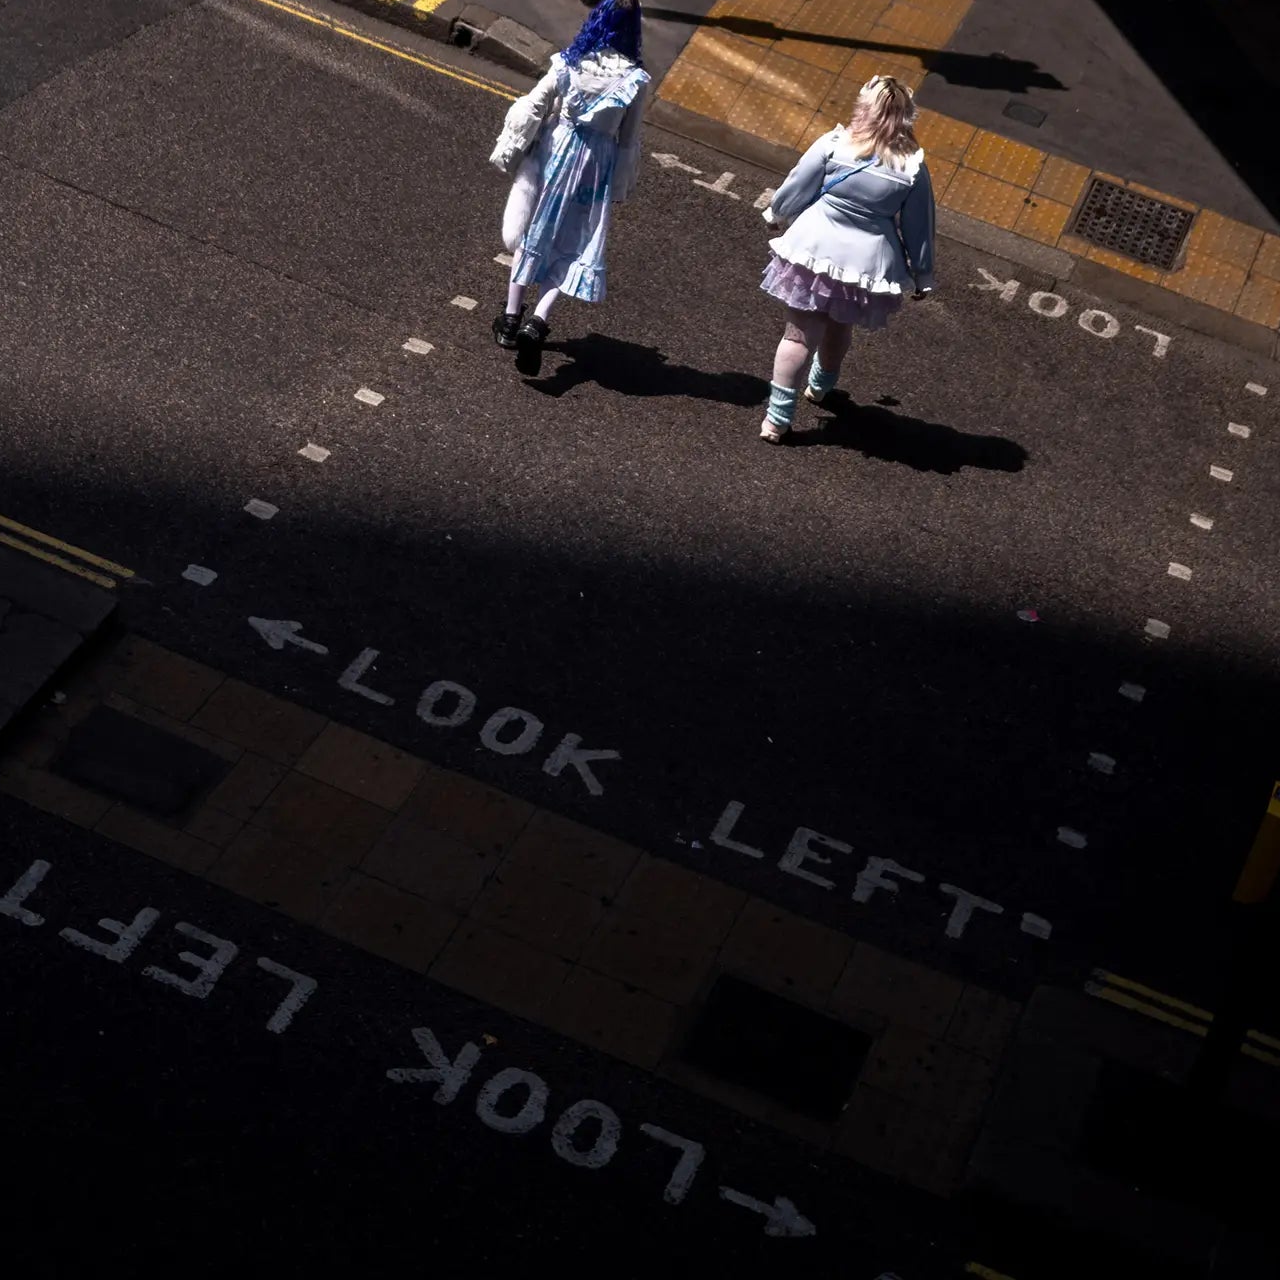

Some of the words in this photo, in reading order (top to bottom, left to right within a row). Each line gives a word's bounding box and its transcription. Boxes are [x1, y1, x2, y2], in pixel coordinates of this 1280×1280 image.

[968, 267, 1173, 359] LOOK
[337, 646, 622, 797] LOOK
[707, 801, 1006, 938] LEFT
[386, 1026, 706, 1205] LOOK
